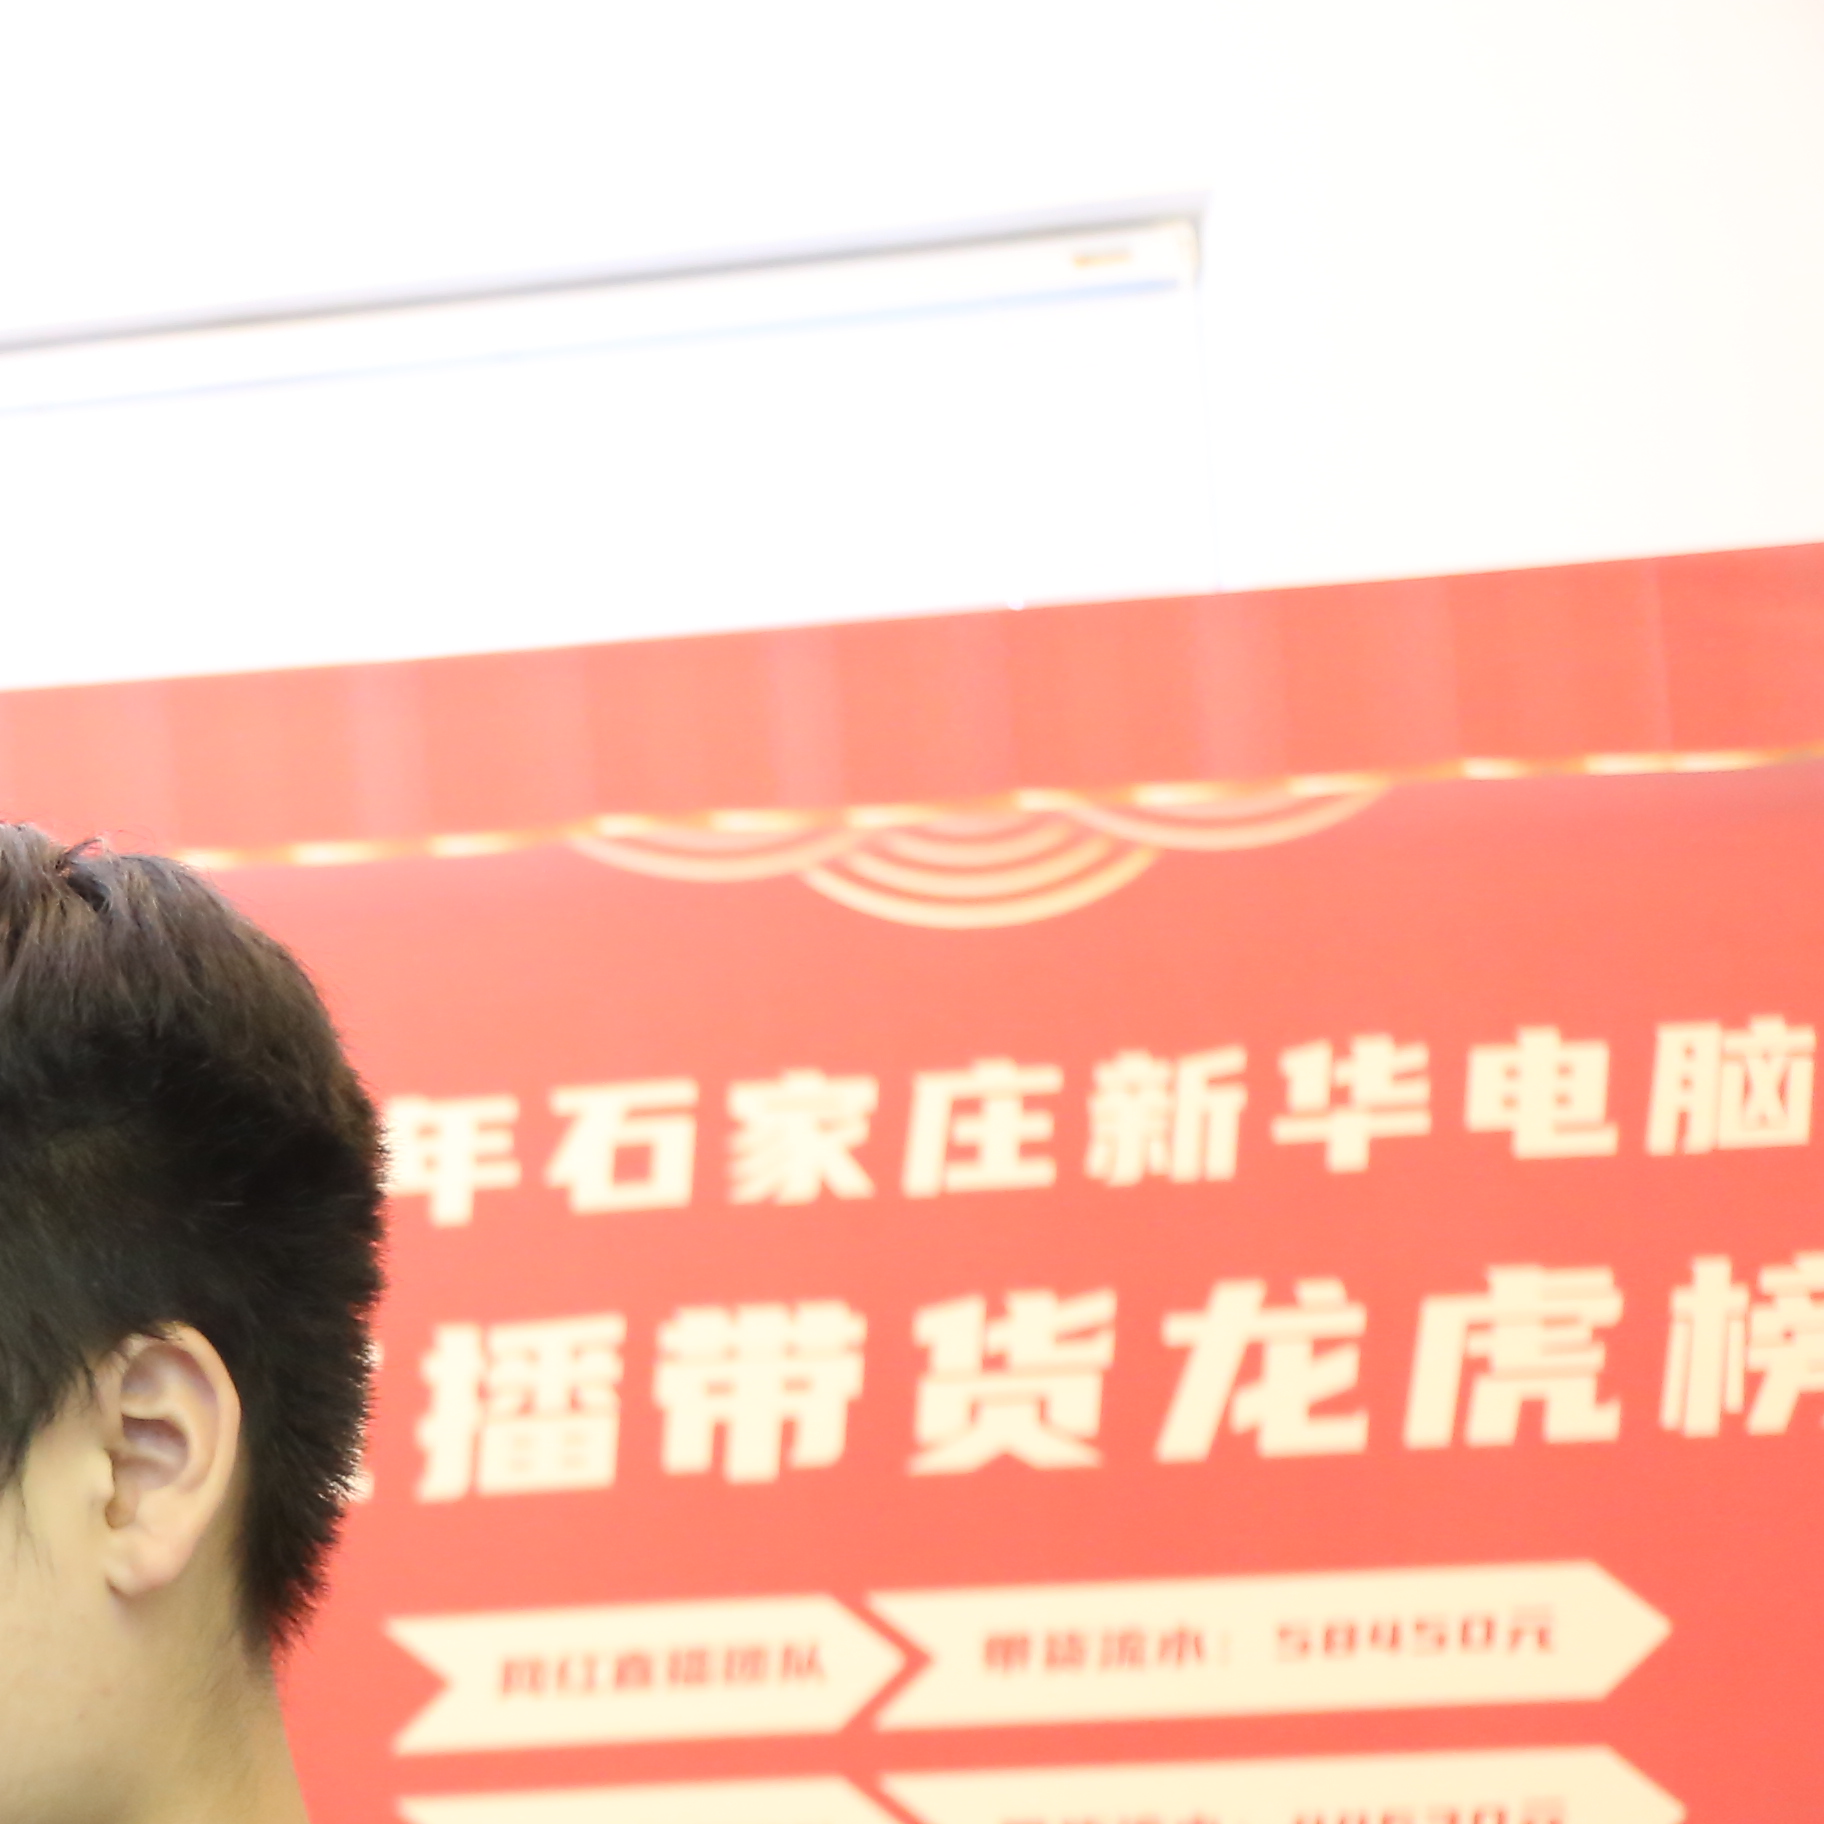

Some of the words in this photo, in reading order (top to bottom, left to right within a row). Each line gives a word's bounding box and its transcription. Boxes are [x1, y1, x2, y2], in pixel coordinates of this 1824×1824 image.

[382, 1014, 1818, 1226] 年石家庄新华电脑
[342, 1250, 1824, 1503] 播带货龙虎榜
